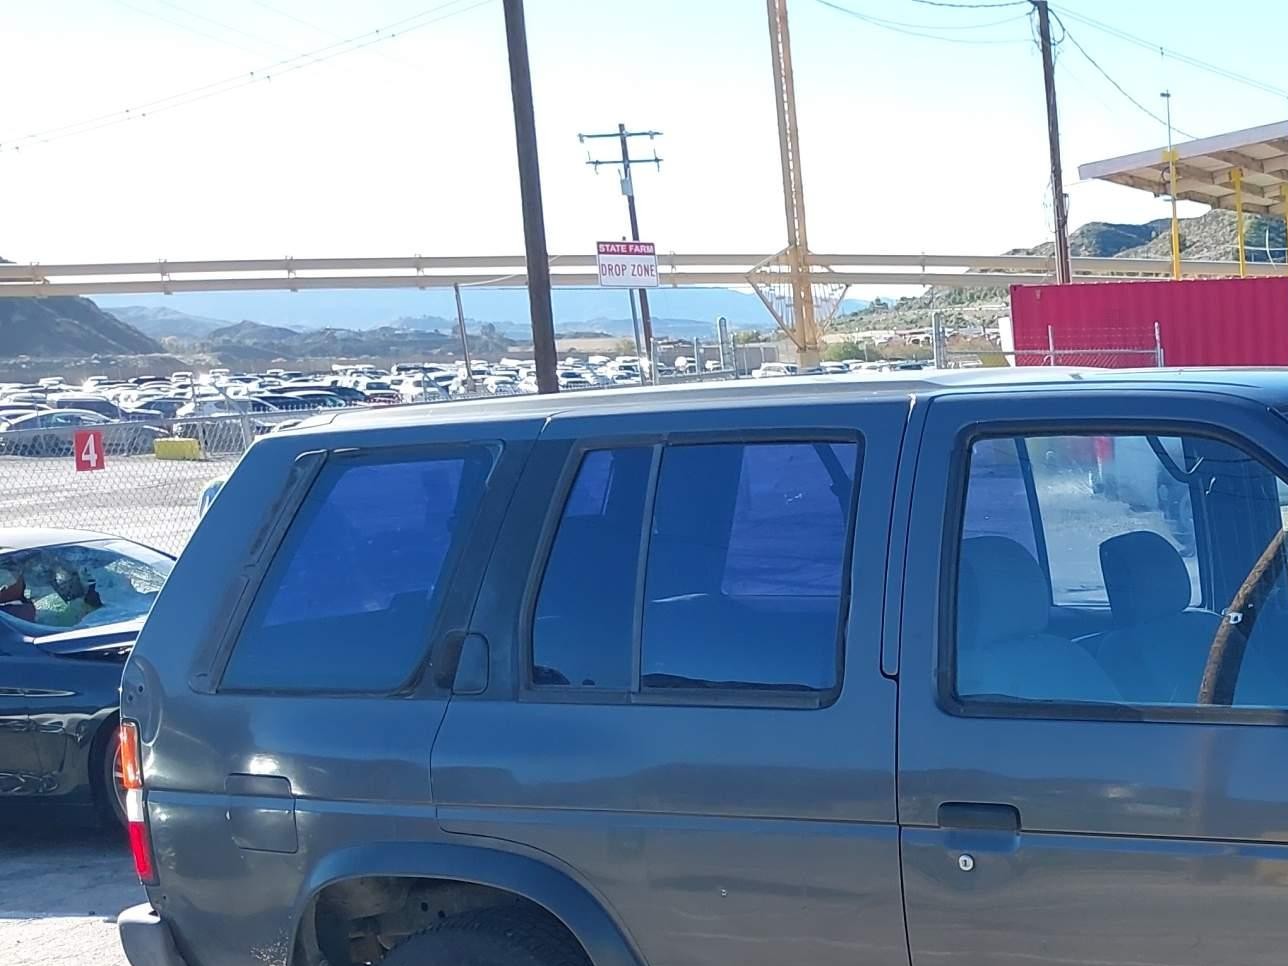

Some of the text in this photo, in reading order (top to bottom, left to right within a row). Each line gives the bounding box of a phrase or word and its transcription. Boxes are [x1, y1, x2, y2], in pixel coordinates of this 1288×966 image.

[599, 244, 654, 253] STATE FARM
[601, 263, 655, 277] DROP ZONE
[81, 433, 97, 467] 4
